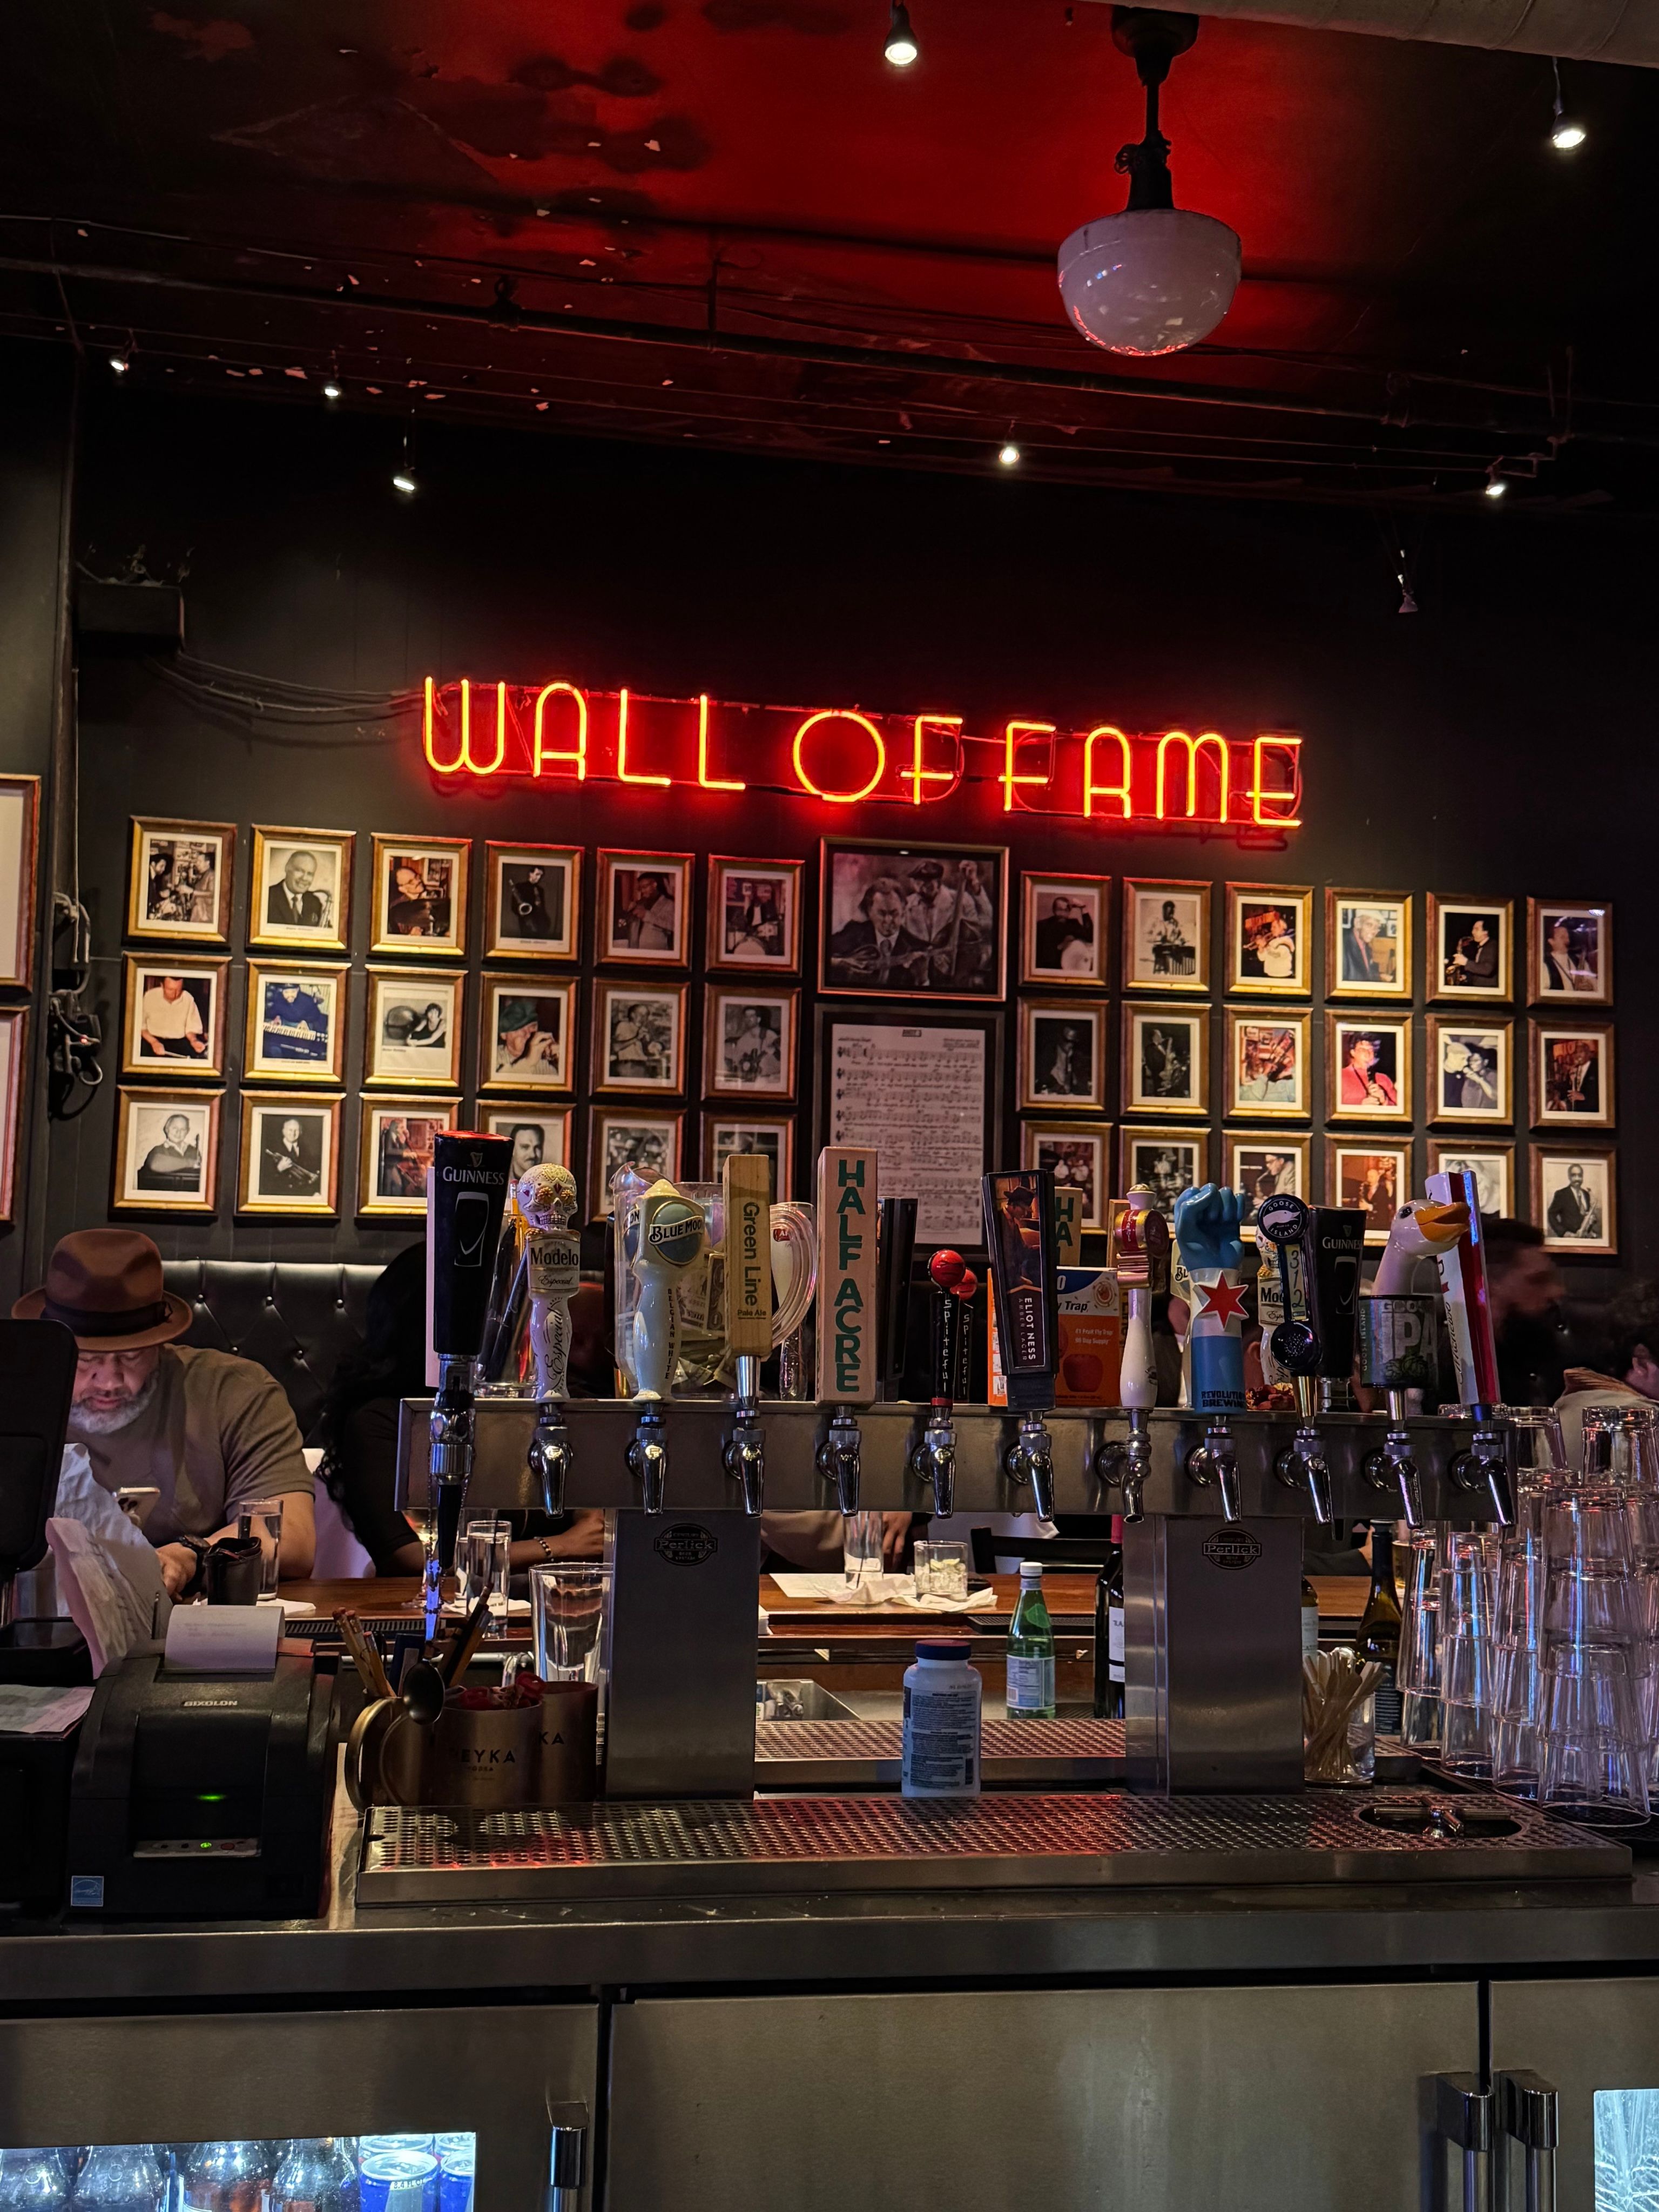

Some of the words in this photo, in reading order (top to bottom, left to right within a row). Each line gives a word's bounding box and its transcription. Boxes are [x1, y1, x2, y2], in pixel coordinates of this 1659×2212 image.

[423, 675, 747, 792] WALL
[791, 709, 964, 805] OF
[997, 720, 1303, 827] FAME
[442, 1166, 505, 1185] GUINNESS
[836, 1159, 866, 1271] HALF
[1268, 1201, 1294, 1211] GOOSE
[649, 1223, 683, 1243] BLUE
[685, 1219, 701, 1233] MOO
[743, 1202, 760, 1260] Green
[1270, 1224, 1298, 1237] ISLAND
[530, 1247, 579, 1266] Modelo
[745, 1266, 761, 1306] Line
[1175, 1267, 1188, 1281] BL
[1290, 1250, 1305, 1308] 312
[1024, 1297, 1034, 1328] ELIOT
[1065, 1300, 1088, 1313] Trap
[544, 1307, 567, 1381] Especial
[833, 1277, 864, 1392] ACRE
[1027, 1332, 1036, 1360] NESS
[665, 1341, 675, 1379] WHITE
[658, 1540, 713, 1549] Perlick
[1207, 1545, 1258, 1554] Perlick
[458, 1749, 516, 1764] EYKA
